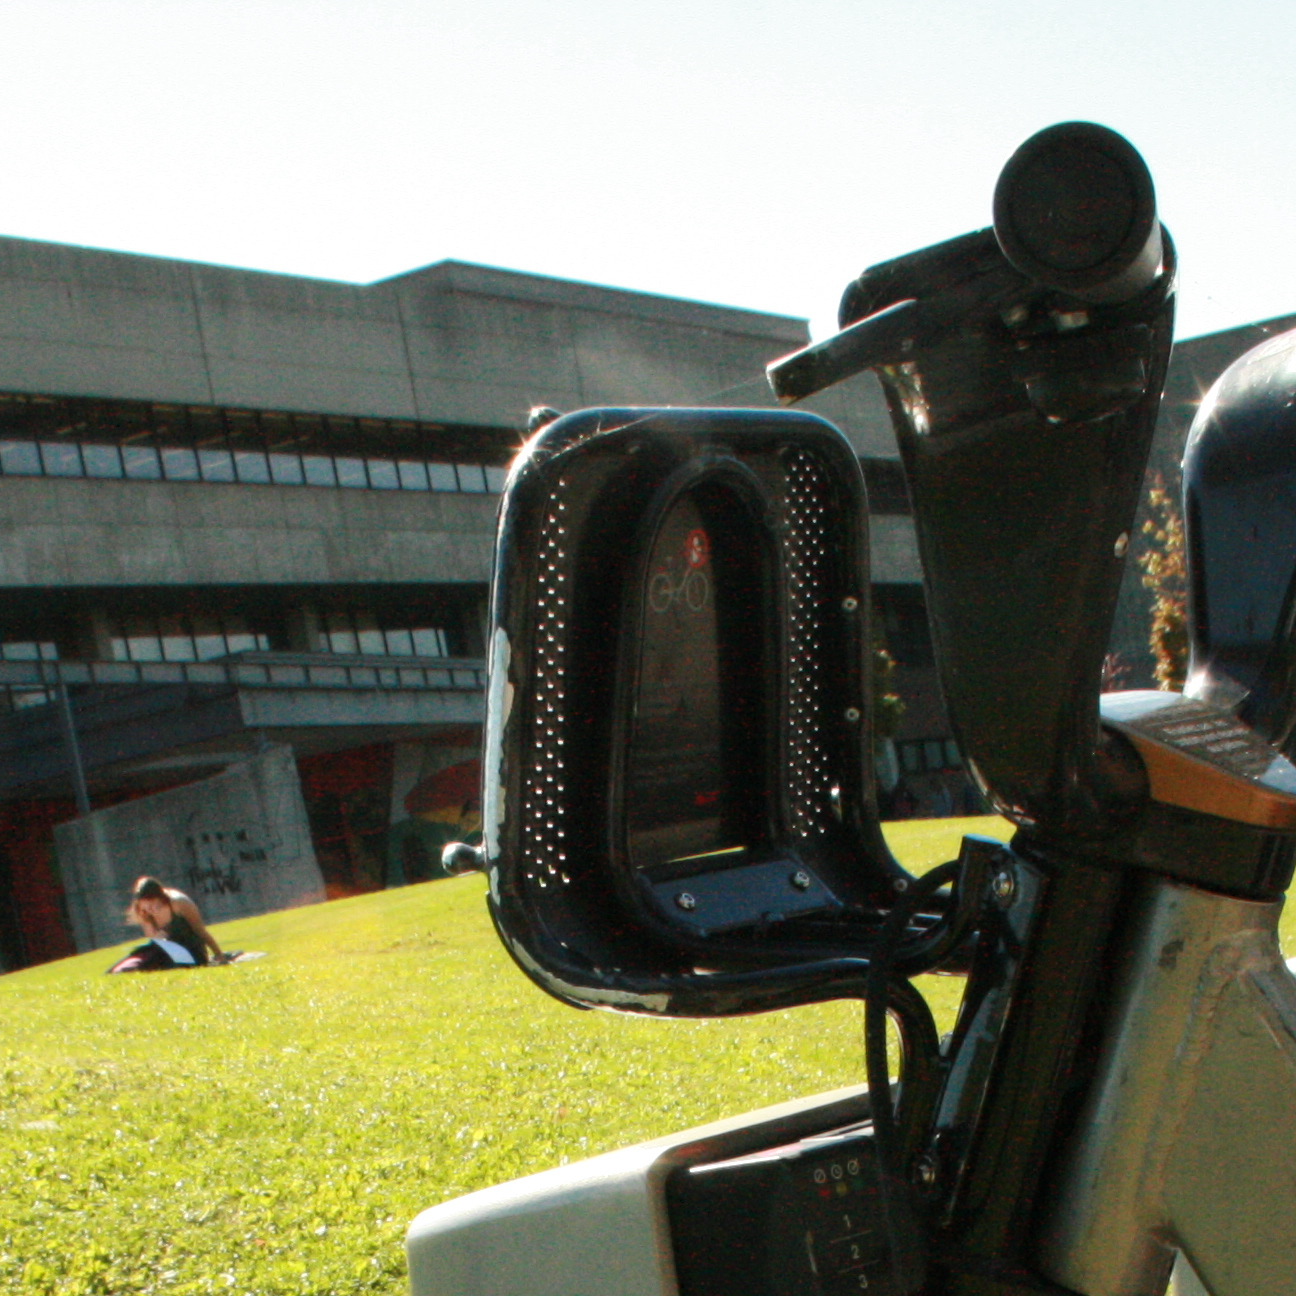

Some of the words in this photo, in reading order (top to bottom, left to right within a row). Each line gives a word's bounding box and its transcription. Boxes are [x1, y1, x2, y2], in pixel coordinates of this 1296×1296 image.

[843, 1213, 852, 1229] 1
[851, 1244, 860, 1259] 2
[858, 1273, 868, 1289] 3
